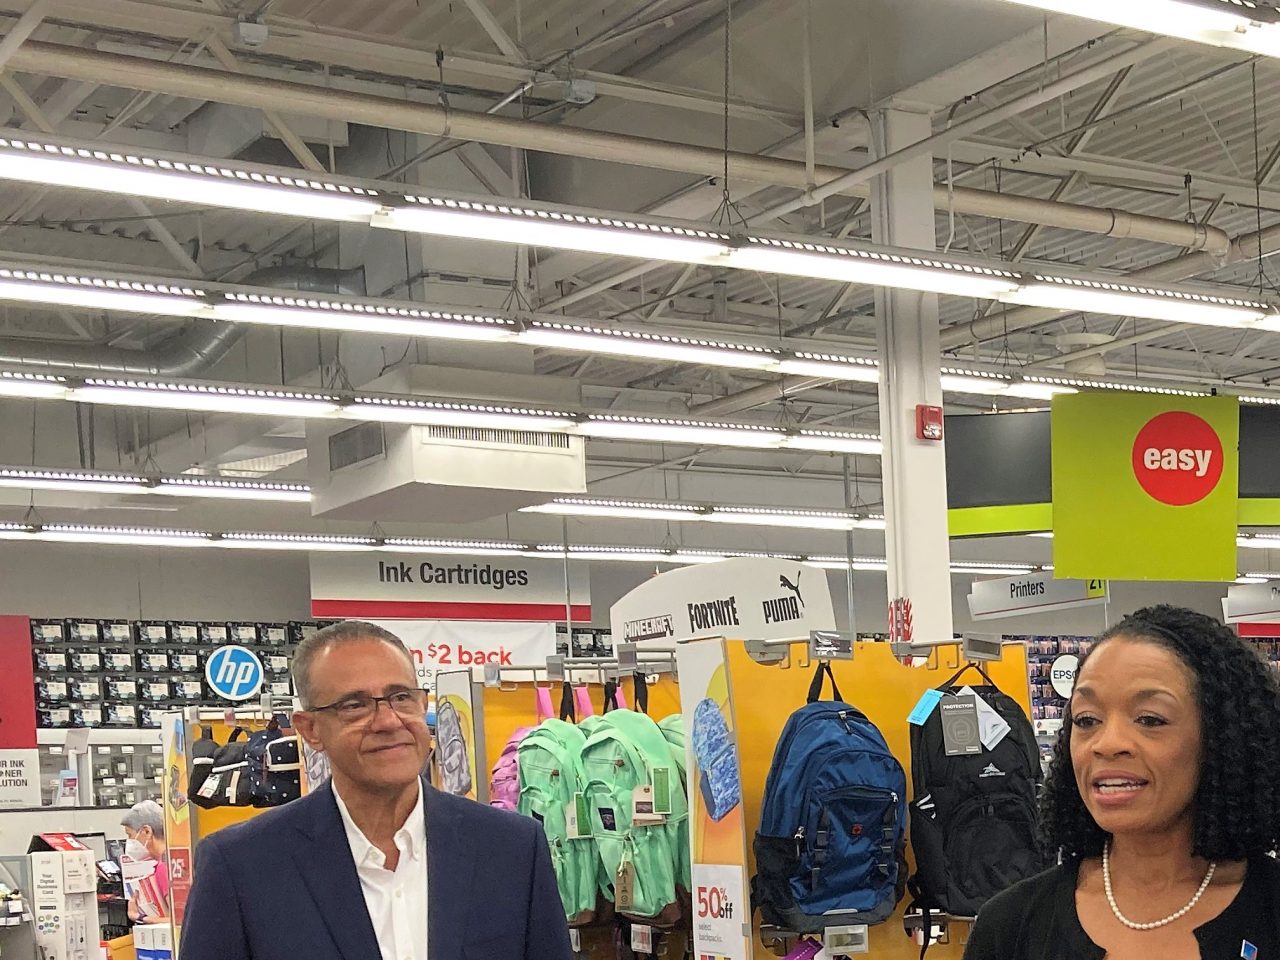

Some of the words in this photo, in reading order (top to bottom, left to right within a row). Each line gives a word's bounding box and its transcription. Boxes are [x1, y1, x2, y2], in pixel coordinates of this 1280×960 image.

[1143, 447, 1212, 477] easy
[378, 561, 413, 583] Ink
[419, 562, 528, 589] Cartridges
[1010, 581, 1045, 599] Printers
[687, 595, 740, 634] FORTNITE
[762, 596, 800, 624] PUMA
[624, 613, 674, 642] MINECRAFT
[427, 643, 451, 664] $2
[458, 645, 512, 666] back
[215, 646, 254, 697] hp
[697, 886, 727, 919] 50%
[719, 903, 733, 919] off
